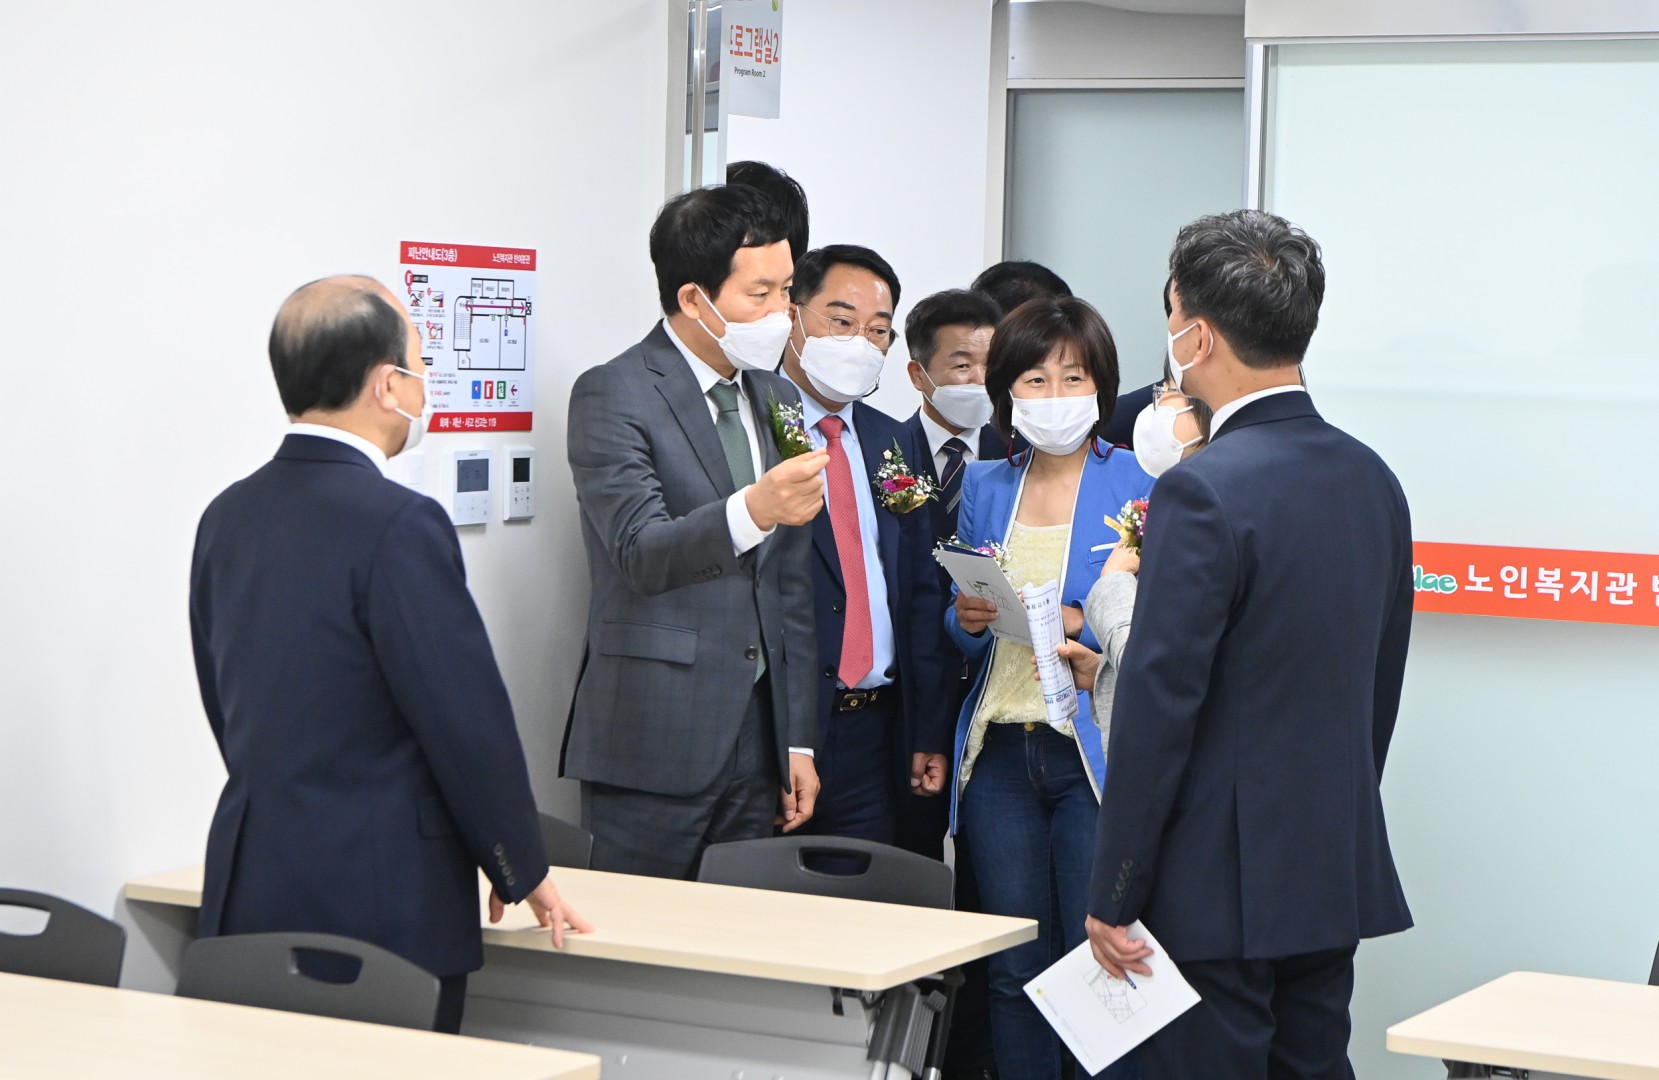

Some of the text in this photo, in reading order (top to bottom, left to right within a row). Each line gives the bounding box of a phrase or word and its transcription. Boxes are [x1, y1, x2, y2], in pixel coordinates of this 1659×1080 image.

[734, 66, 751, 77] Program
[751, 68, 763, 77] Room
[407, 246, 458, 263] 피난안내도(3층)
[1464, 564, 1638, 605] 노인복지관
